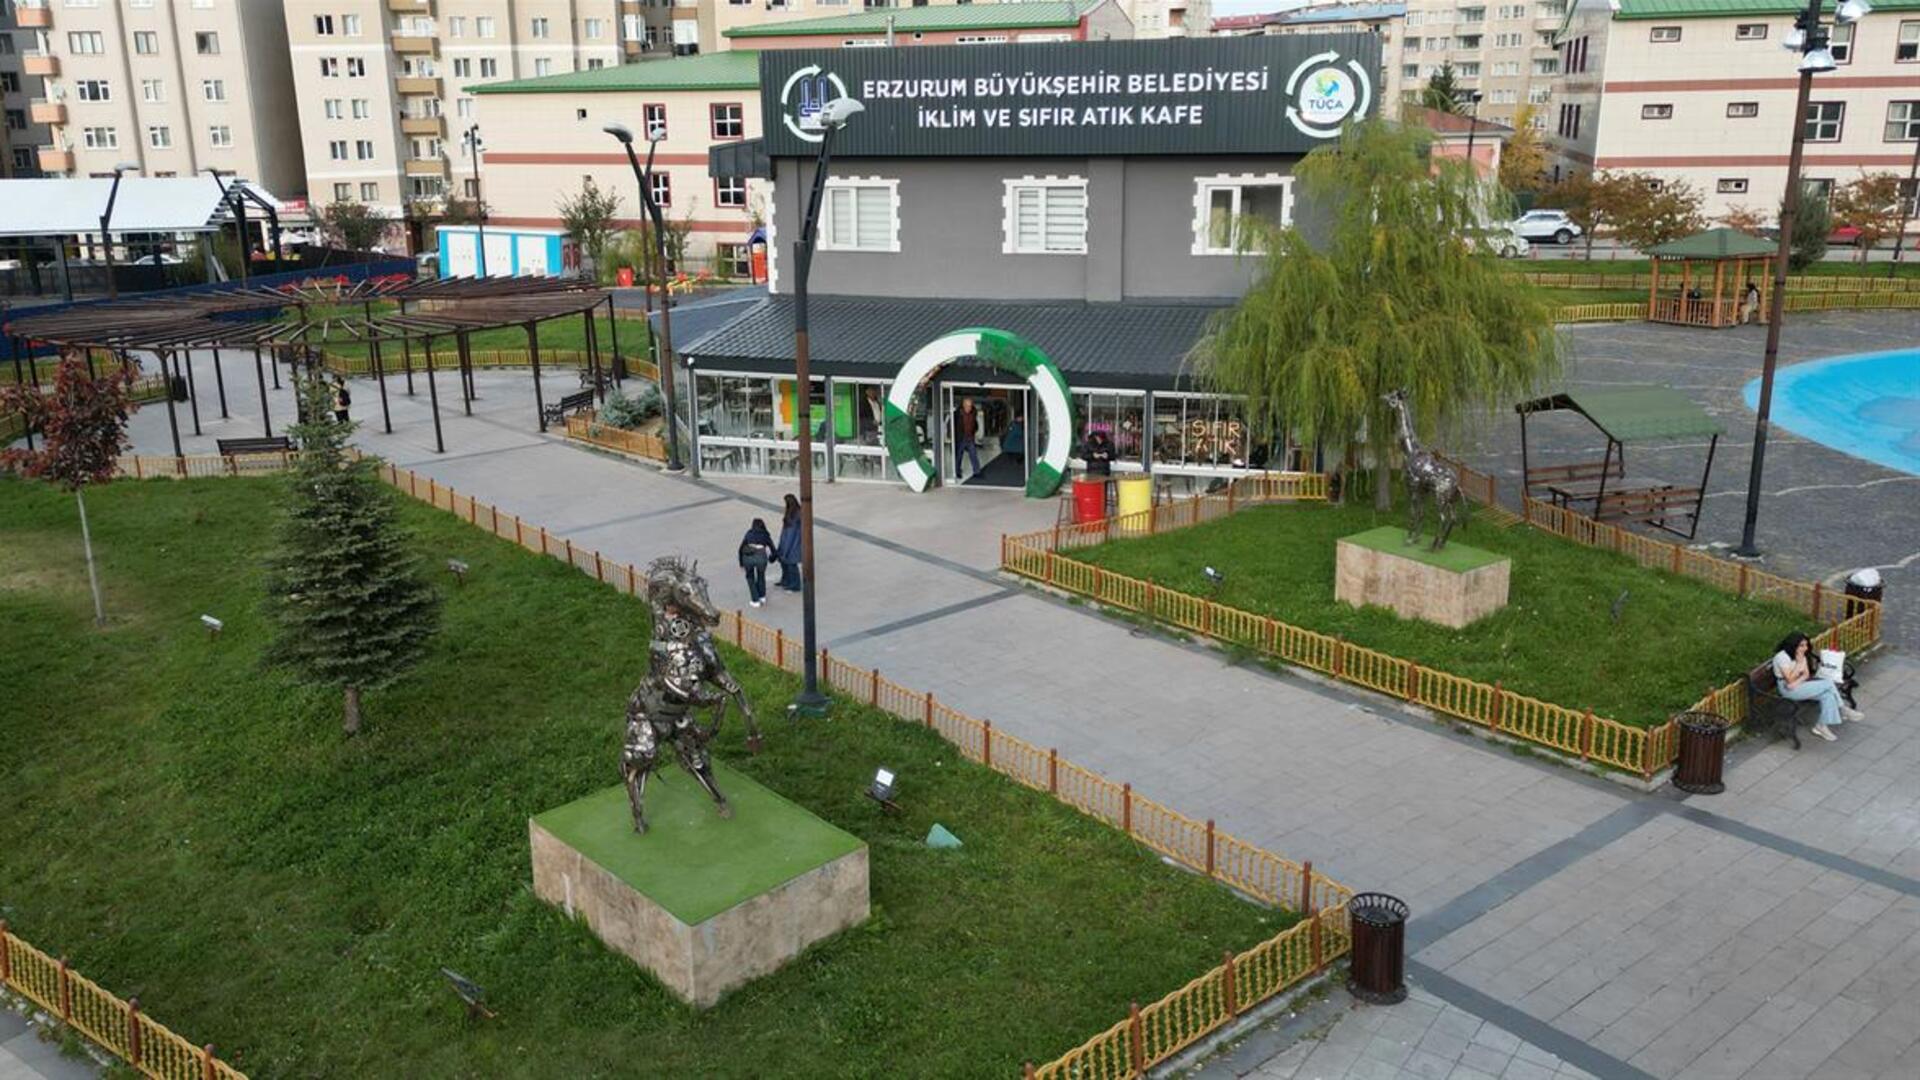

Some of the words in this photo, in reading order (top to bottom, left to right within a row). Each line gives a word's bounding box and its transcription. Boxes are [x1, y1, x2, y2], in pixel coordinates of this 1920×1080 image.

[863, 78, 967, 98] ERZURUM
[974, 70, 1121, 98] BÜYÜKŞEHİR
[1127, 66, 1268, 94] BELEDİYESİ
[918, 105, 976, 128] İKLİM
[983, 108, 1011, 127] VE
[1018, 107, 1076, 127] SIFIR
[1081, 106, 1134, 126] ATIK
[1140, 105, 1203, 125] KAFE
